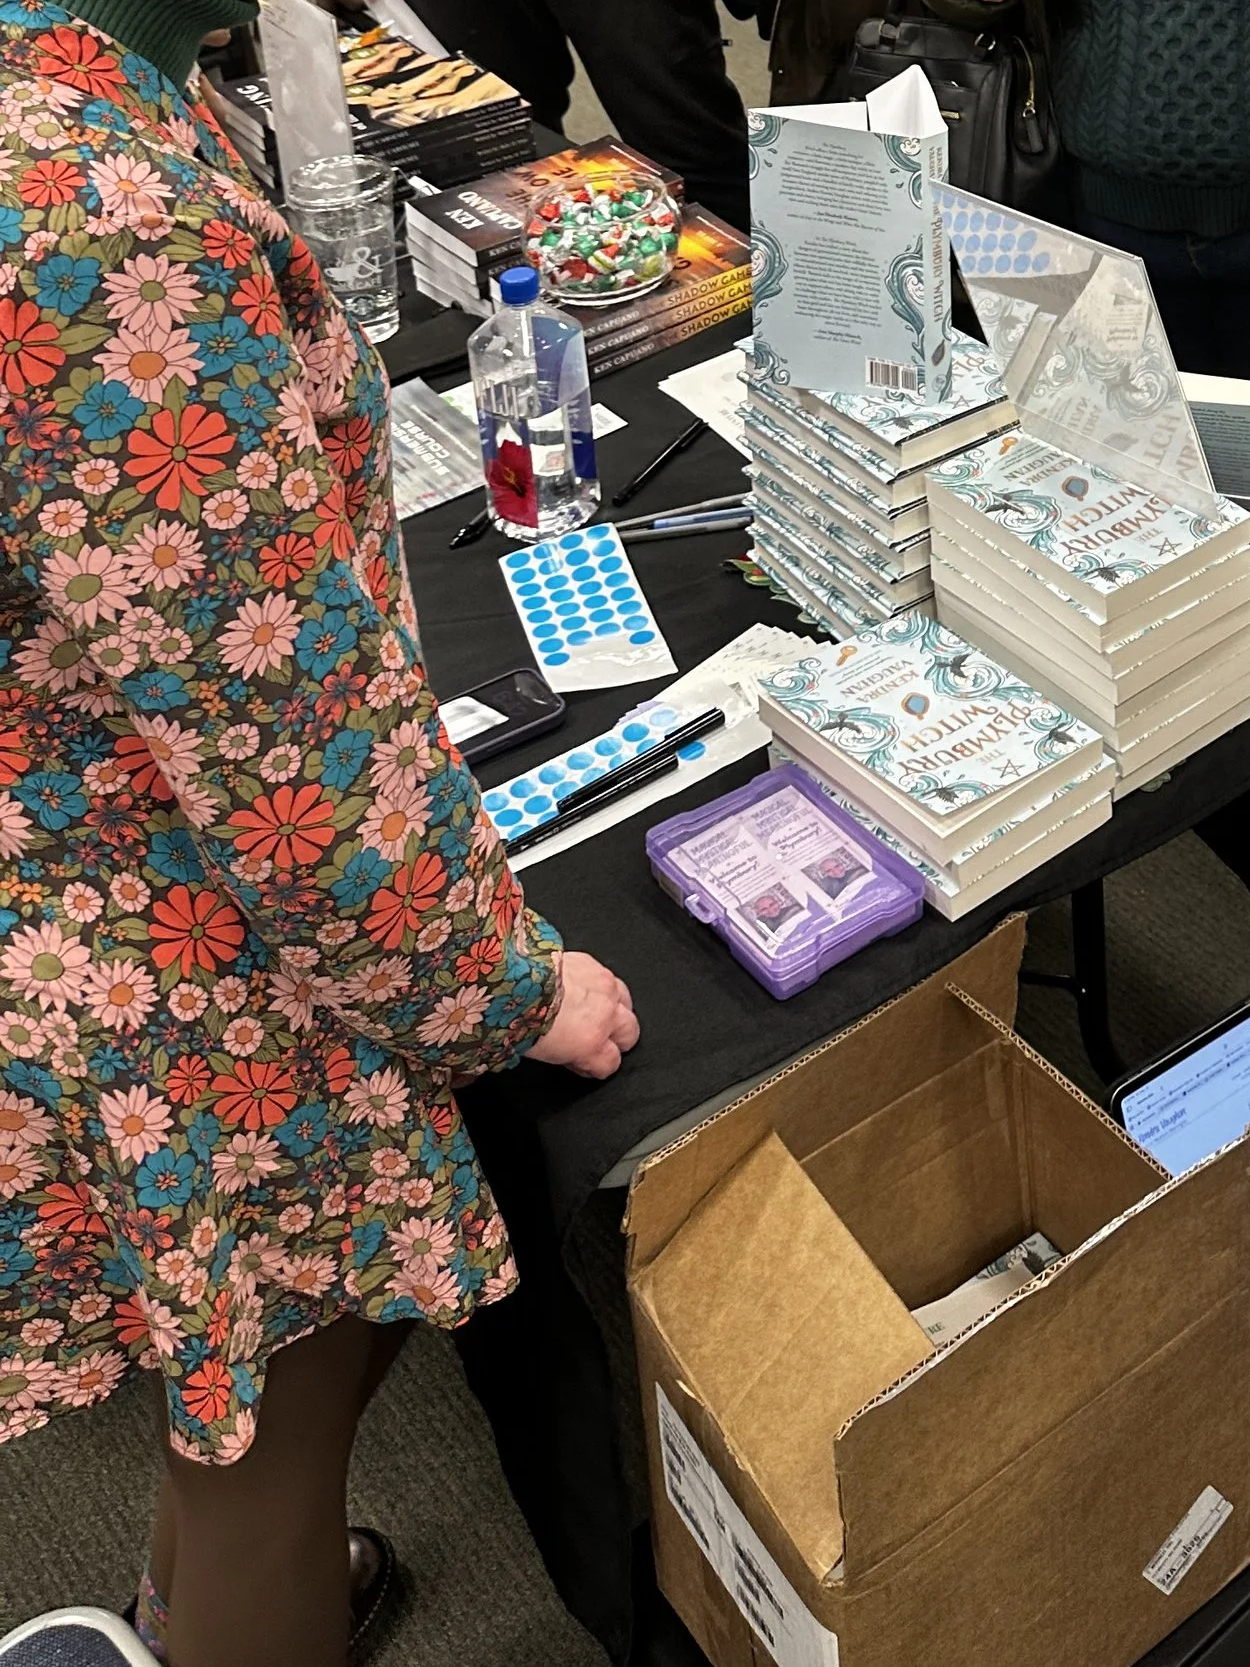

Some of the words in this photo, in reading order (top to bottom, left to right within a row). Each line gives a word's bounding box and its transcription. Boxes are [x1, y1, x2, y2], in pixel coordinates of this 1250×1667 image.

[444, 204, 484, 230] KEN
[457, 190, 523, 229] CAPUANO
[932, 216, 943, 280] PLYMBURY
[586, 341, 607, 354] KEN
[606, 324, 650, 348] CAPUANO
[674, 290, 730, 319] SHADOW
[727, 281, 753, 299] GAM
[595, 308, 640, 332] CAPUANO
[666, 277, 722, 306] SHADOW
[932, 281, 943, 323] WITCH
[592, 360, 613, 374] KEN
[611, 342, 656, 366] CAPUANO
[678, 308, 732, 336] SHADOW
[400, 418, 450, 459] COURSE
[1002, 449, 1063, 484] AUGHAN
[1020, 458, 1077, 488] KENDRA
[1062, 485, 1148, 534] WITCH
[841, 657, 912, 700] VAUGHAN
[864, 668, 921, 703] KENDRA
[896, 699, 1032, 775] PLYMBURY
[900, 704, 1000, 755] WITCH
[974, 748, 1006, 767] THE
